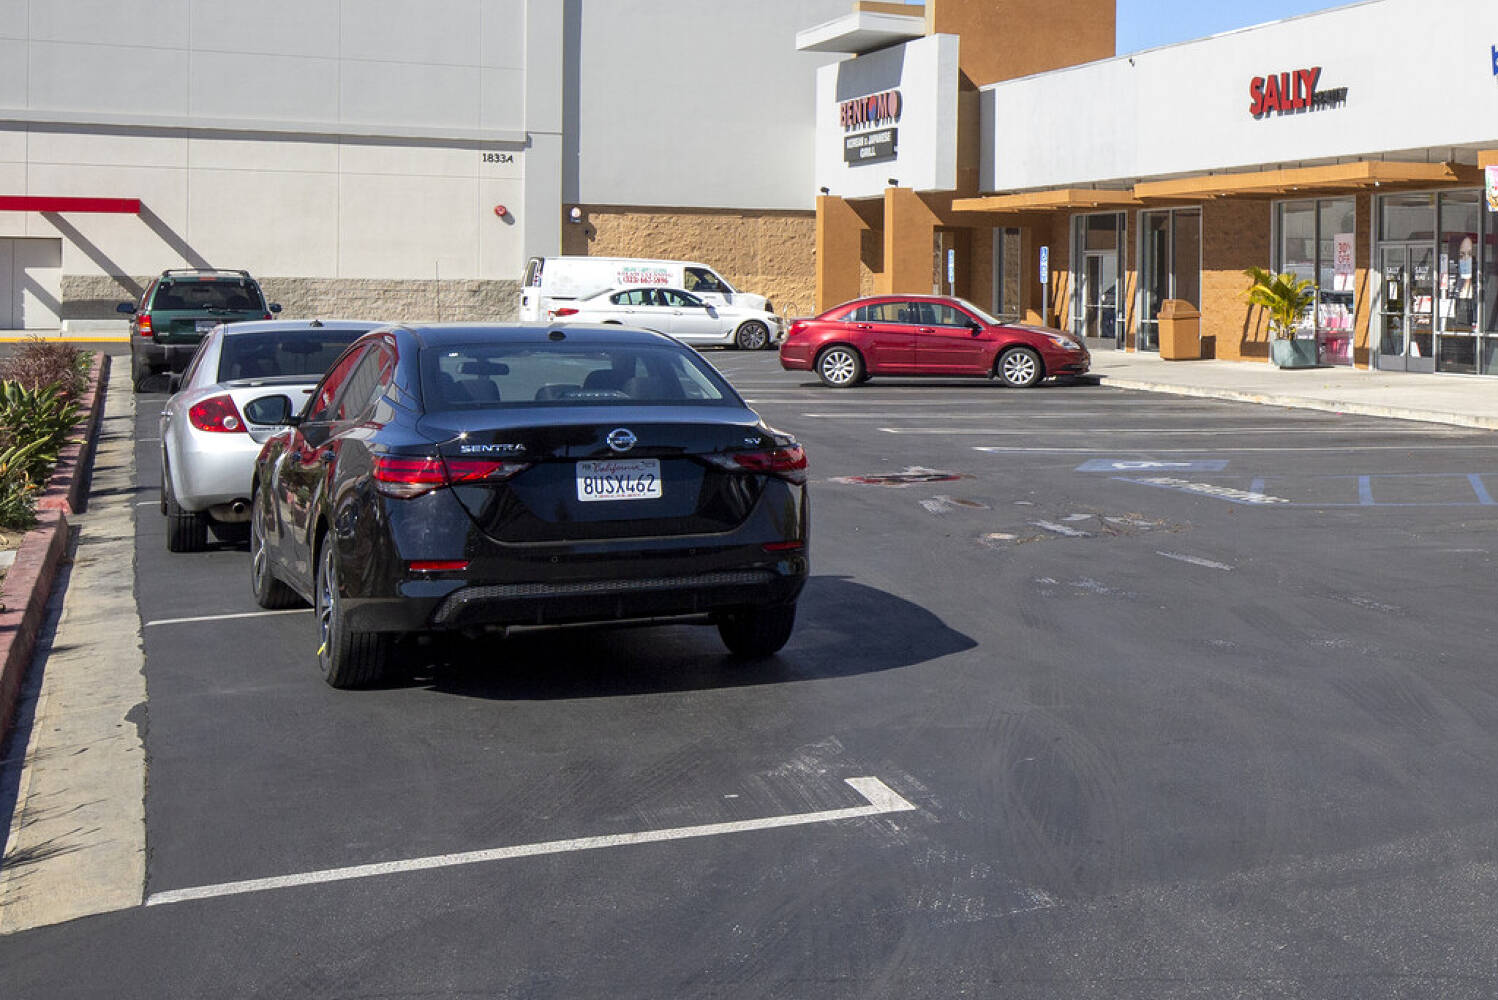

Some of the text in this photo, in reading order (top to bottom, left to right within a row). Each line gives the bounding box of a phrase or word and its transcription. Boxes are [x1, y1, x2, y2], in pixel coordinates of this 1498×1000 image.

[1249, 66, 1319, 116] SALLY
[482, 153, 513, 164] 1833A
[461, 444, 527, 453] SENTRA
[583, 474, 656, 494] 8USX462
